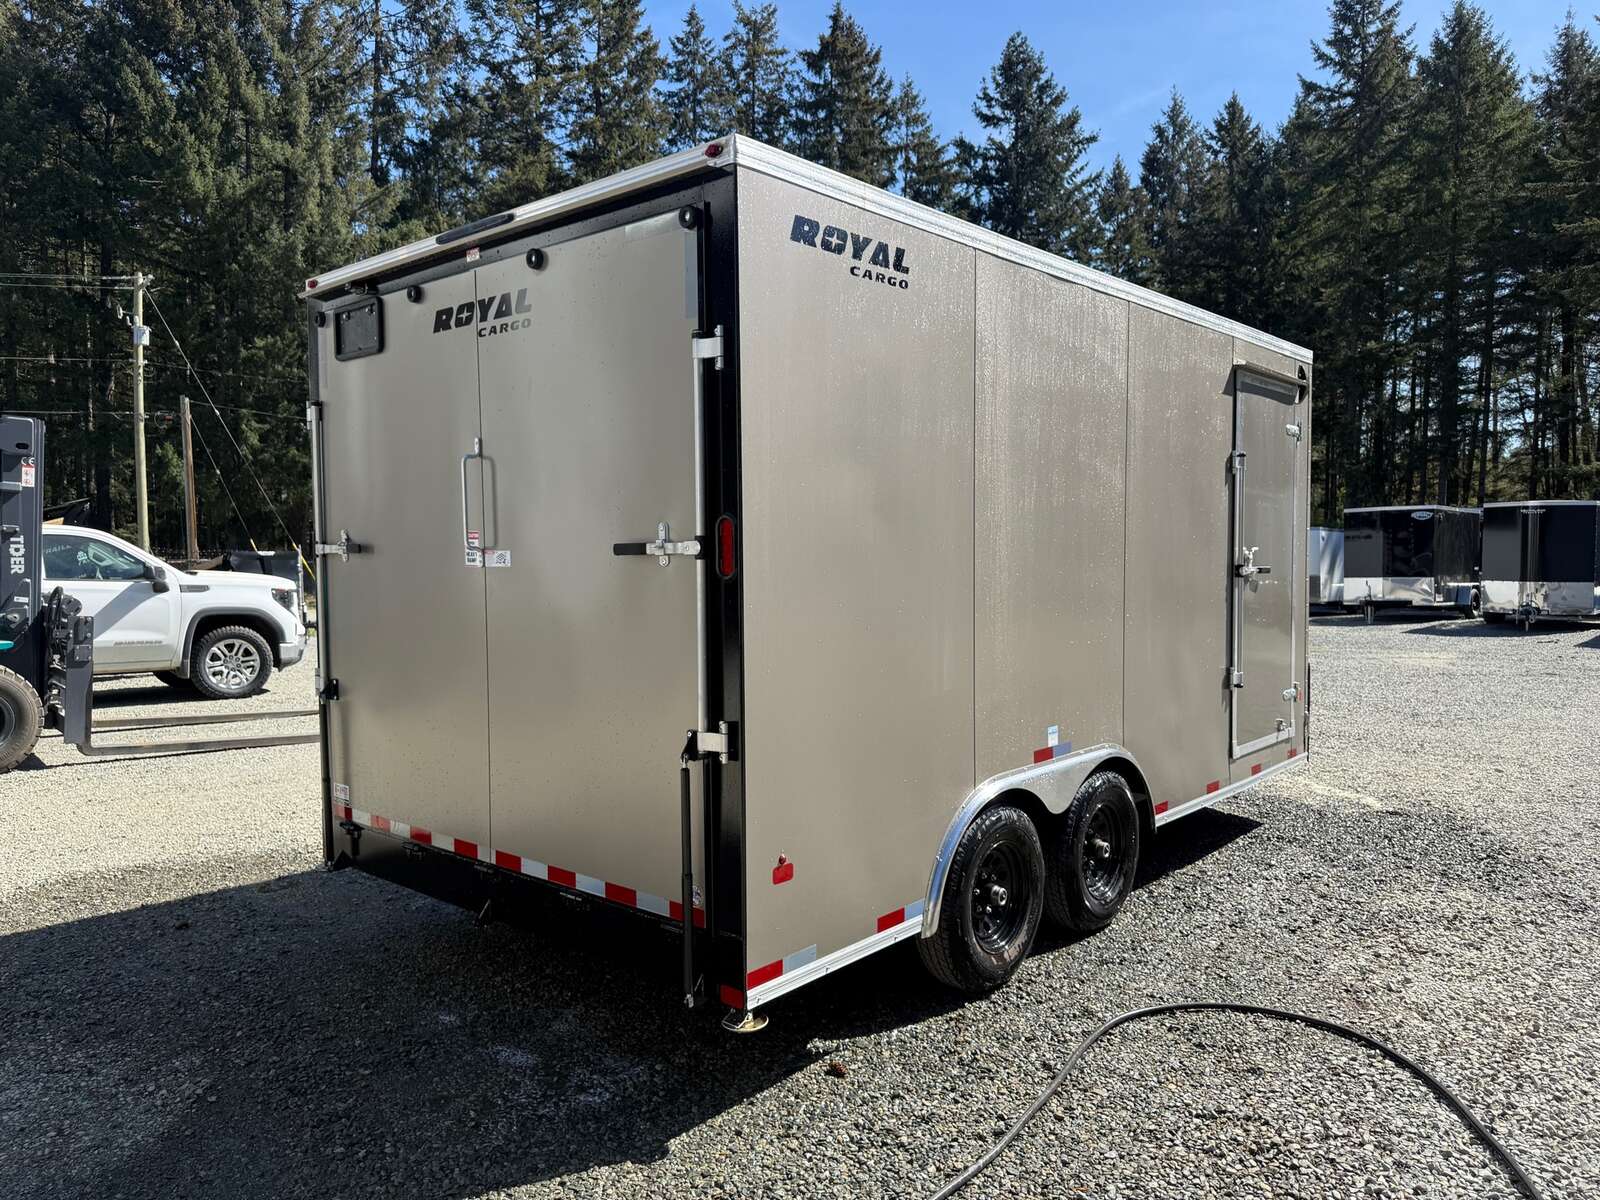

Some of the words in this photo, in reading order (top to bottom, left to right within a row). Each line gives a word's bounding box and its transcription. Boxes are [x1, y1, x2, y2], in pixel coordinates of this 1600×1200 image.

[790, 214, 910, 275] ROYAL
[849, 265, 909, 290] CARGO
[433, 288, 532, 334] ROYAL
[478, 318, 532, 337] CARGO
